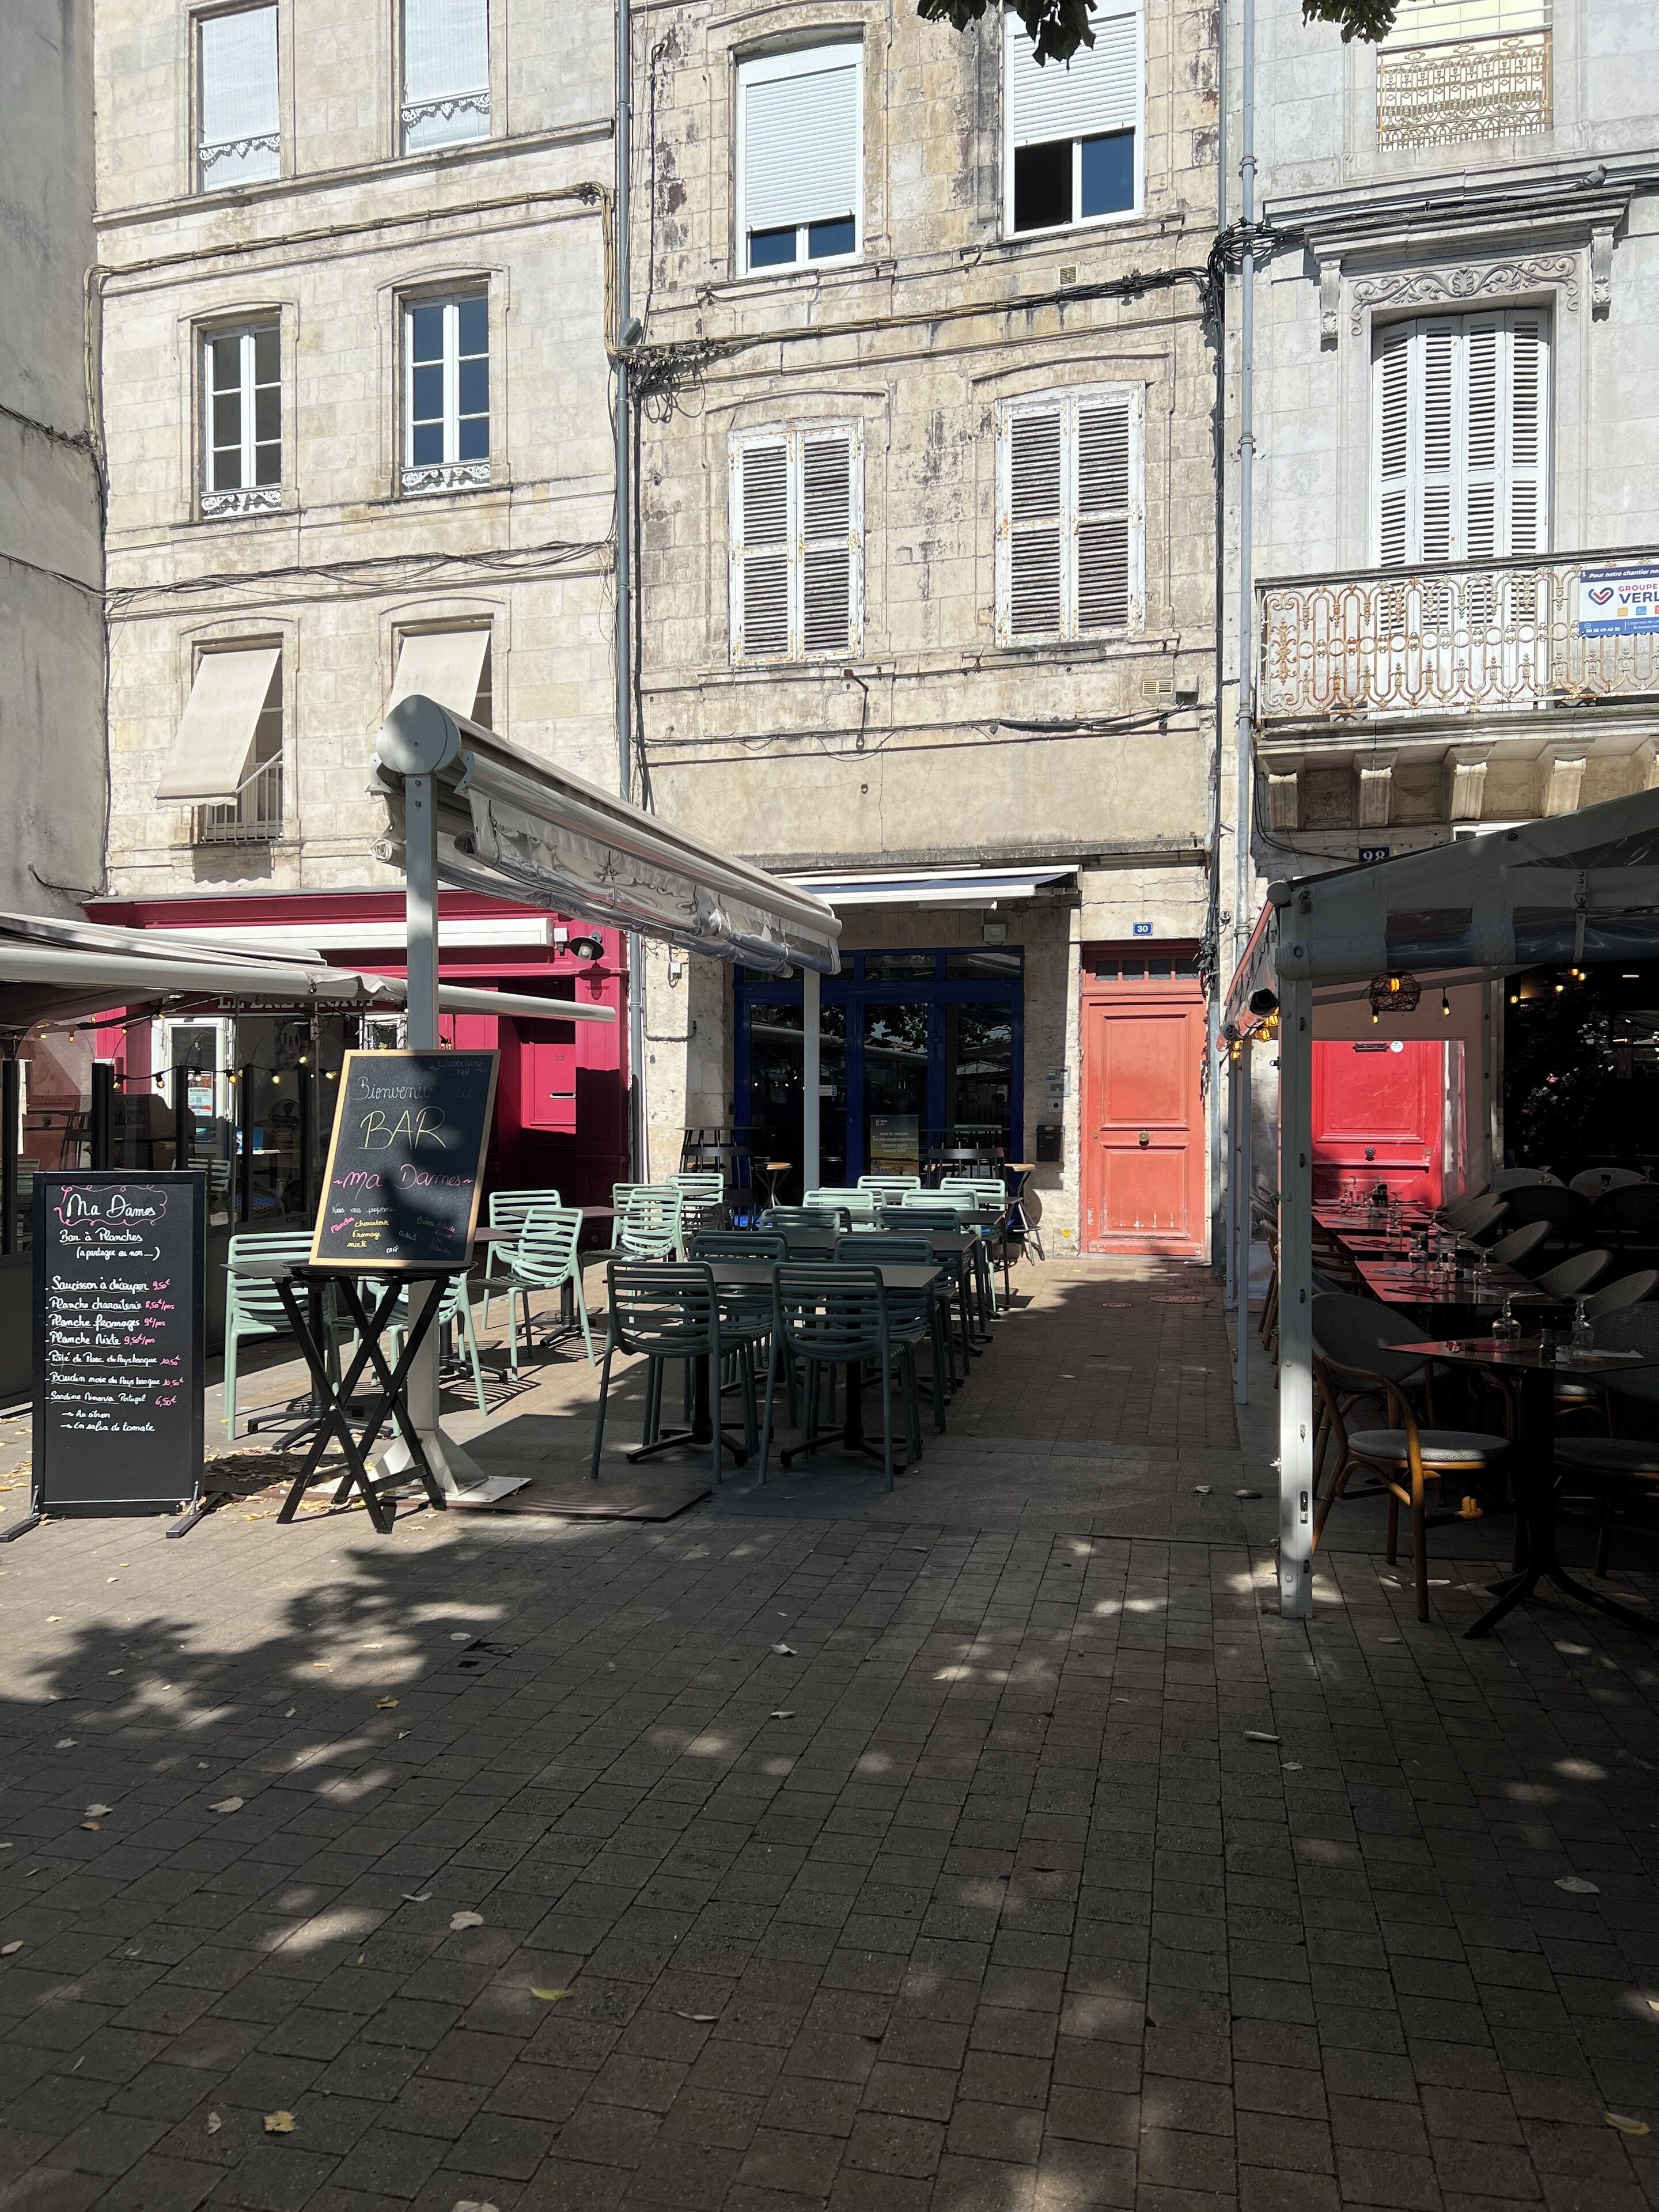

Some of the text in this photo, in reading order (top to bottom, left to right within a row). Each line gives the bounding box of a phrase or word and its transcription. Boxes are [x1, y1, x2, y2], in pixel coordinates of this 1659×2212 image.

[1618, 584, 1658, 592] GROUPE
[350, 1076, 433, 1100] Bienvenue
[358, 1106, 447, 1150] BAR
[395, 1164, 461, 1190] Dames
[67, 1194, 156, 1218] Ma Dames
[59, 1227, 143, 1243] Bar à Planches
[52, 1275, 99, 1290] Saucisson
[100, 1277, 108, 1290] à
[109, 1278, 150, 1294] découper
[48, 1313, 92, 1326] Planche
[93, 1313, 140, 1331] fromages
[49, 1331, 91, 1344] Planche
[73, 1354, 83, 1363] de
[83, 1351, 105, 1363] Porc
[107, 1354, 116, 1362] du
[50, 1372, 86, 1384] Boudin
[118, 1376, 135, 1387] Pays
[135, 1377, 161, 1388] basque
[118, 1392, 146, 1405] Portugal
[75, 1409, 87, 1417] Au
[122, 1421, 156, 1432] tomate
